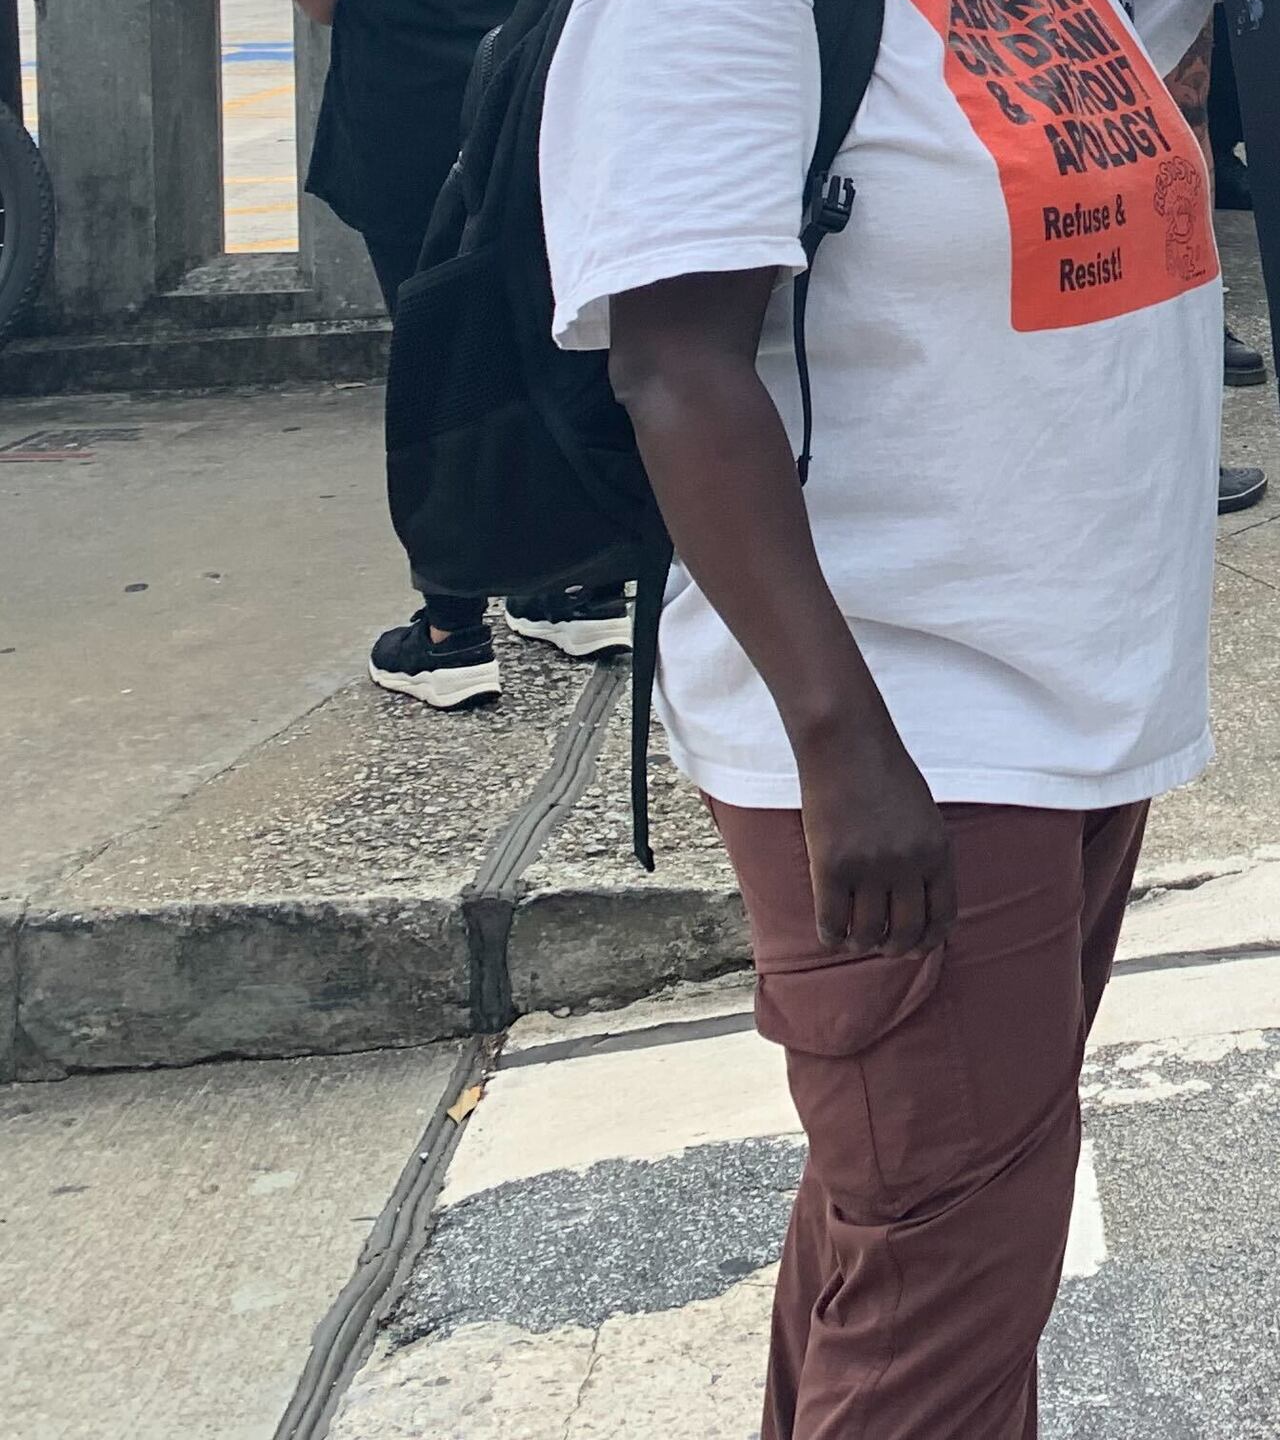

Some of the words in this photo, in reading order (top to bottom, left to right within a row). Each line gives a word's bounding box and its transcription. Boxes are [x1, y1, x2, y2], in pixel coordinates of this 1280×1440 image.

[1043, 106, 1171, 176] APOLOGY
[1043, 202, 1110, 241] Refuse
[1115, 193, 1126, 227] &
[1060, 247, 1122, 292] Resist!
